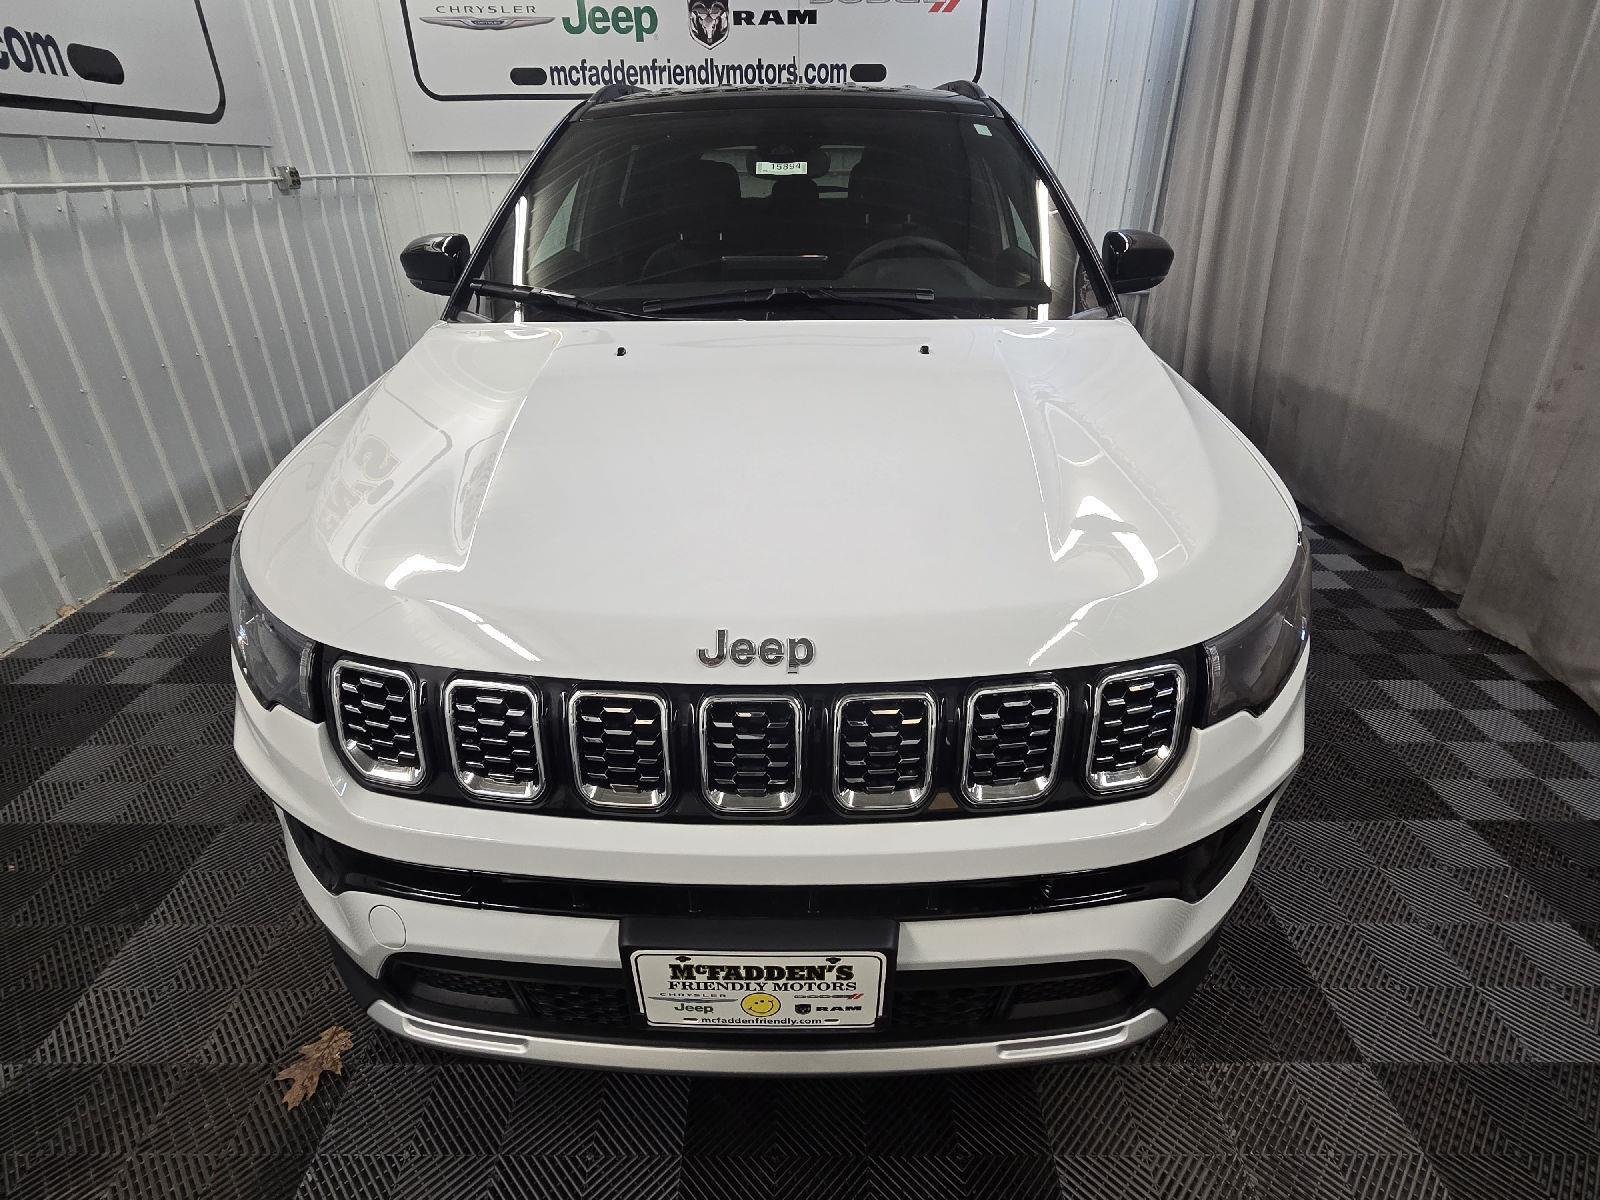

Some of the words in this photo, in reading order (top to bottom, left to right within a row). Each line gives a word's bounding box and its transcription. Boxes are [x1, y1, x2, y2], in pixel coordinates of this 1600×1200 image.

[435, 5, 537, 14] CHRYSLER
[562, 0, 658, 43] Jeep
[732, 9, 817, 26] RAM
[549, 57, 848, 87] mcfaddenfriendlymotors.com
[696, 629, 816, 674] Jeep
[668, 981, 768, 992] FRIENDLY
[772, 982, 857, 992] MOTORS
[674, 1003, 714, 1014] Jeep
[701, 1017, 822, 1025] mcfaddenfriendly.com
